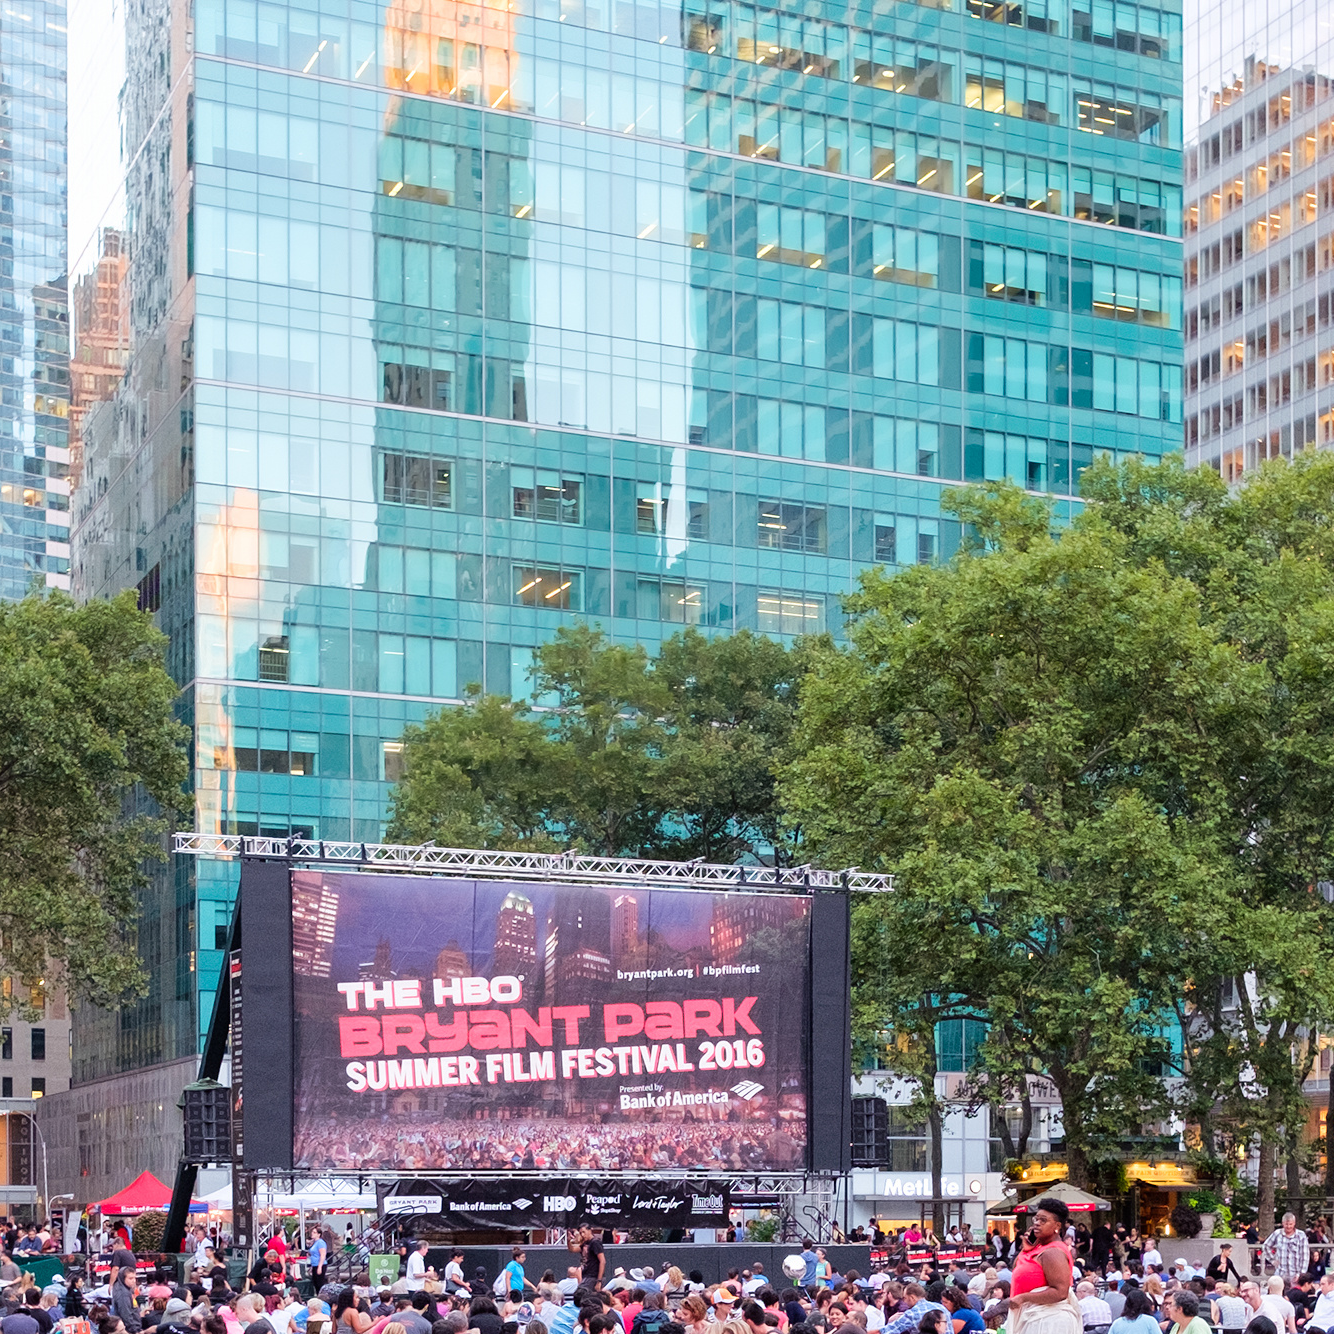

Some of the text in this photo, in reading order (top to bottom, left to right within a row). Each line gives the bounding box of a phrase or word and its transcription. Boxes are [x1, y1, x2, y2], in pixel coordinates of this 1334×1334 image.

[616, 964, 760, 981] bryantpark.org #bpfilmfest
[337, 979, 423, 1012] THE
[346, 1038, 766, 1093] SUMMER FILM FESTIVAL 2016
[619, 1084, 653, 1093] Presented
[620, 1089, 729, 1110] Bank of America
[884, 1177, 959, 1196] MetLfe
[449, 1201, 512, 1211] Bank of America
[543, 1195, 577, 1212] HBO
[586, 1194, 621, 1206] Peapod
